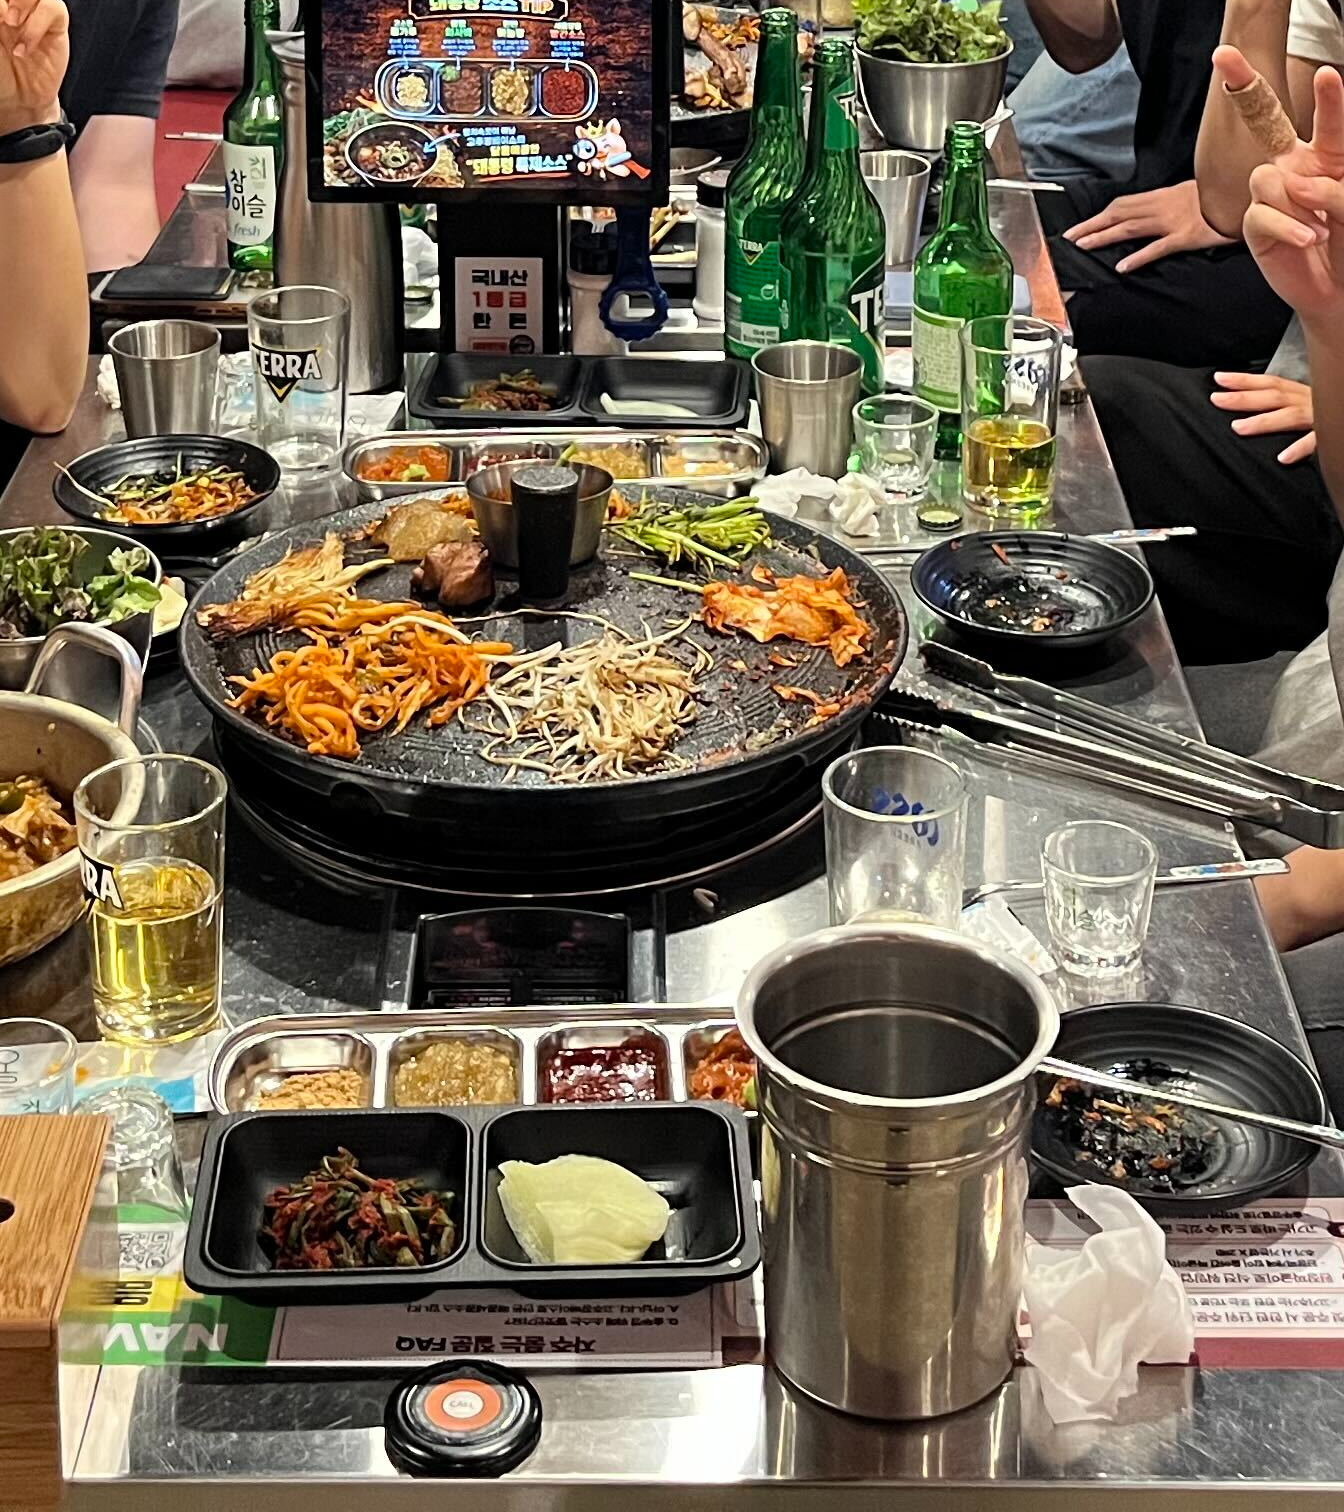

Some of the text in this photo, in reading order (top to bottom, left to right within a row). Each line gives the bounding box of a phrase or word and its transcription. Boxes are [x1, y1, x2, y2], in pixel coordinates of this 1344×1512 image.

[230, 168, 247, 194] 참
[231, 193, 267, 220] 이슬
[233, 223, 261, 238] fresh
[471, 269, 528, 287] 국내산
[1302, 1311, 1332, 1323] 주문
[102, 1323, 229, 1353] NAV
[395, 1335, 596, 1354] 자주 묻는 질문 FAQ
